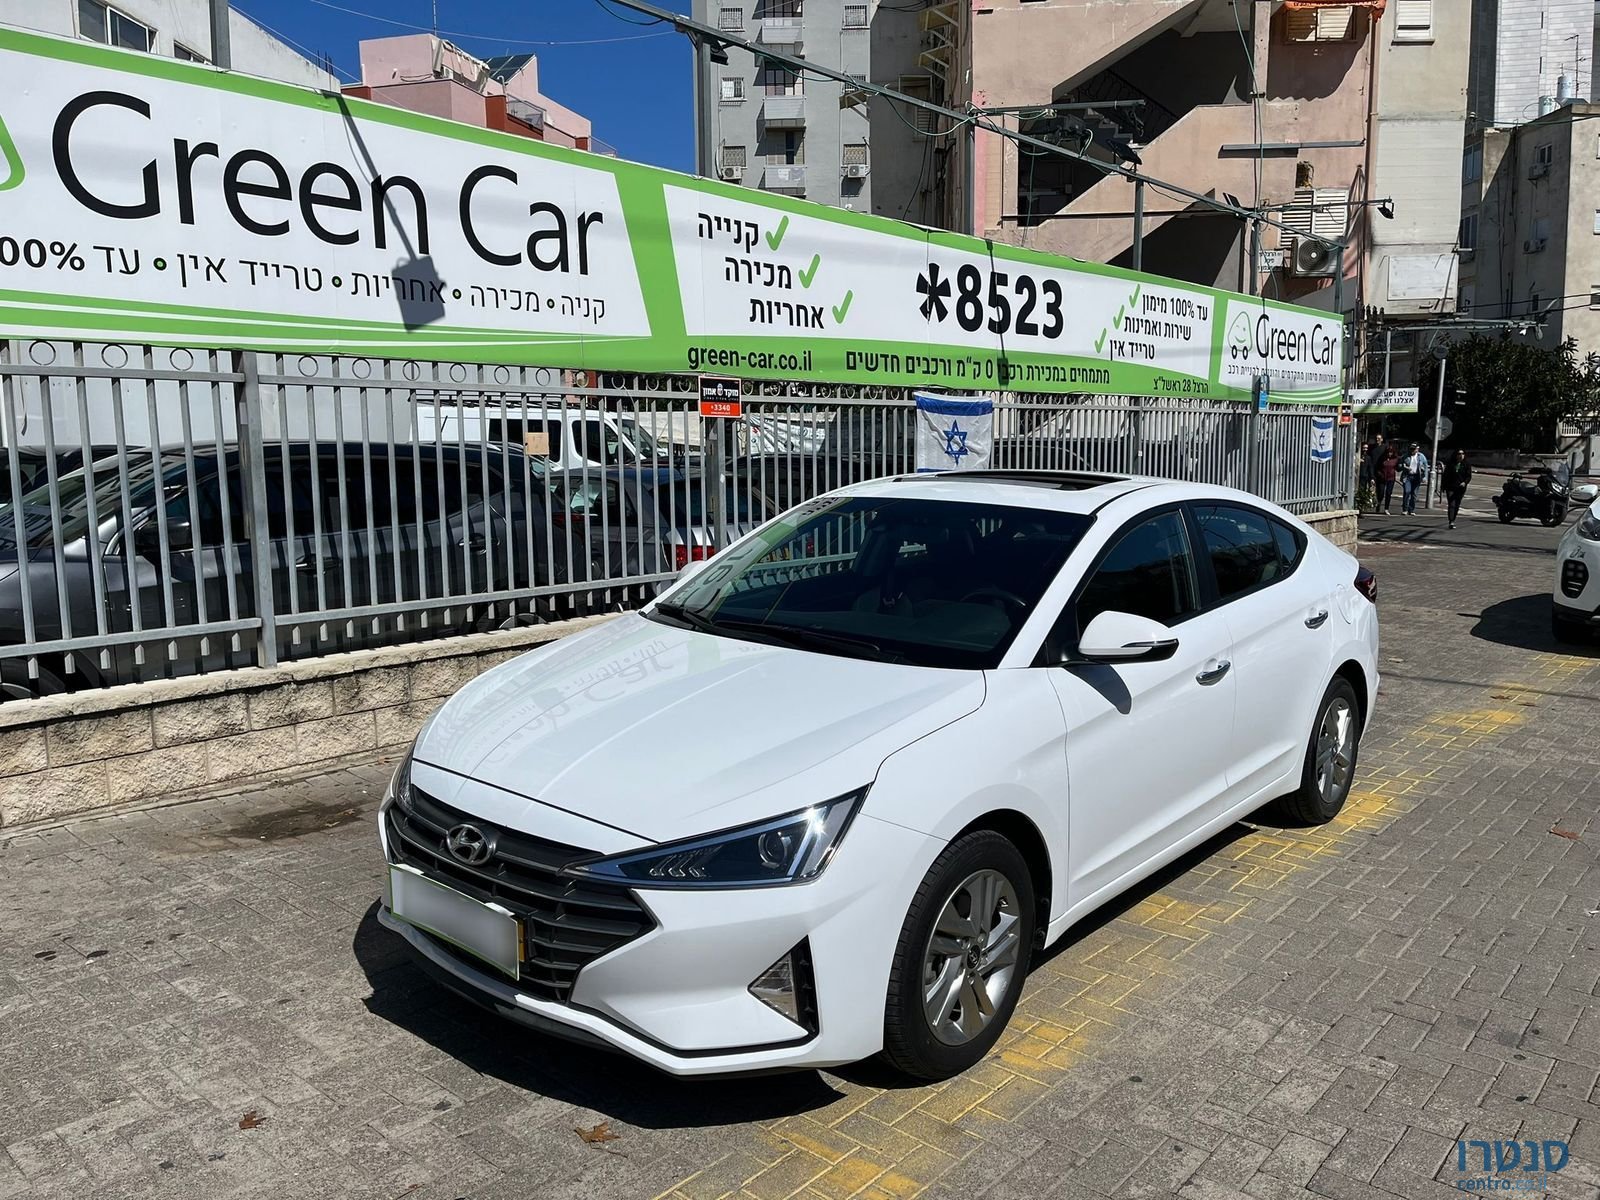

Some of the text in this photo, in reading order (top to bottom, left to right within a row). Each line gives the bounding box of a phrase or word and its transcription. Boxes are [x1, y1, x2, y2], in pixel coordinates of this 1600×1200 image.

[52, 90, 604, 276] Green Car
[698, 212, 759, 253] קנייה
[93, 245, 140, 275] עד
[177, 254, 227, 288] אין
[725, 256, 792, 289] מכירה
[239, 260, 323, 292] טרייד
[351, 272, 446, 304] אחריות
[470, 285, 540, 312] מכירה
[561, 295, 605, 324] קניה
[1142, 294, 1208, 321] עד 100% מימון
[749, 298, 824, 329] אחריות
[1124, 316, 1191, 341] שירות ואמינות
[1256, 314, 1337, 366] Green Car
[687, 346, 813, 370] green-car.co.il
[846, 351, 900, 373] חדשים
[1109, 339, 1155, 361] טרייד אין
[906, 355, 952, 376] ורכבים
[986, 358, 993, 379] 0
[1026, 364, 1067, 383] במכירת
[1070, 366, 1110, 384] מתמחים
[1228, 364, 1239, 374] רכב
[1182, 378, 1191, 392] 28
[1192, 379, 1208, 393] הרצל
